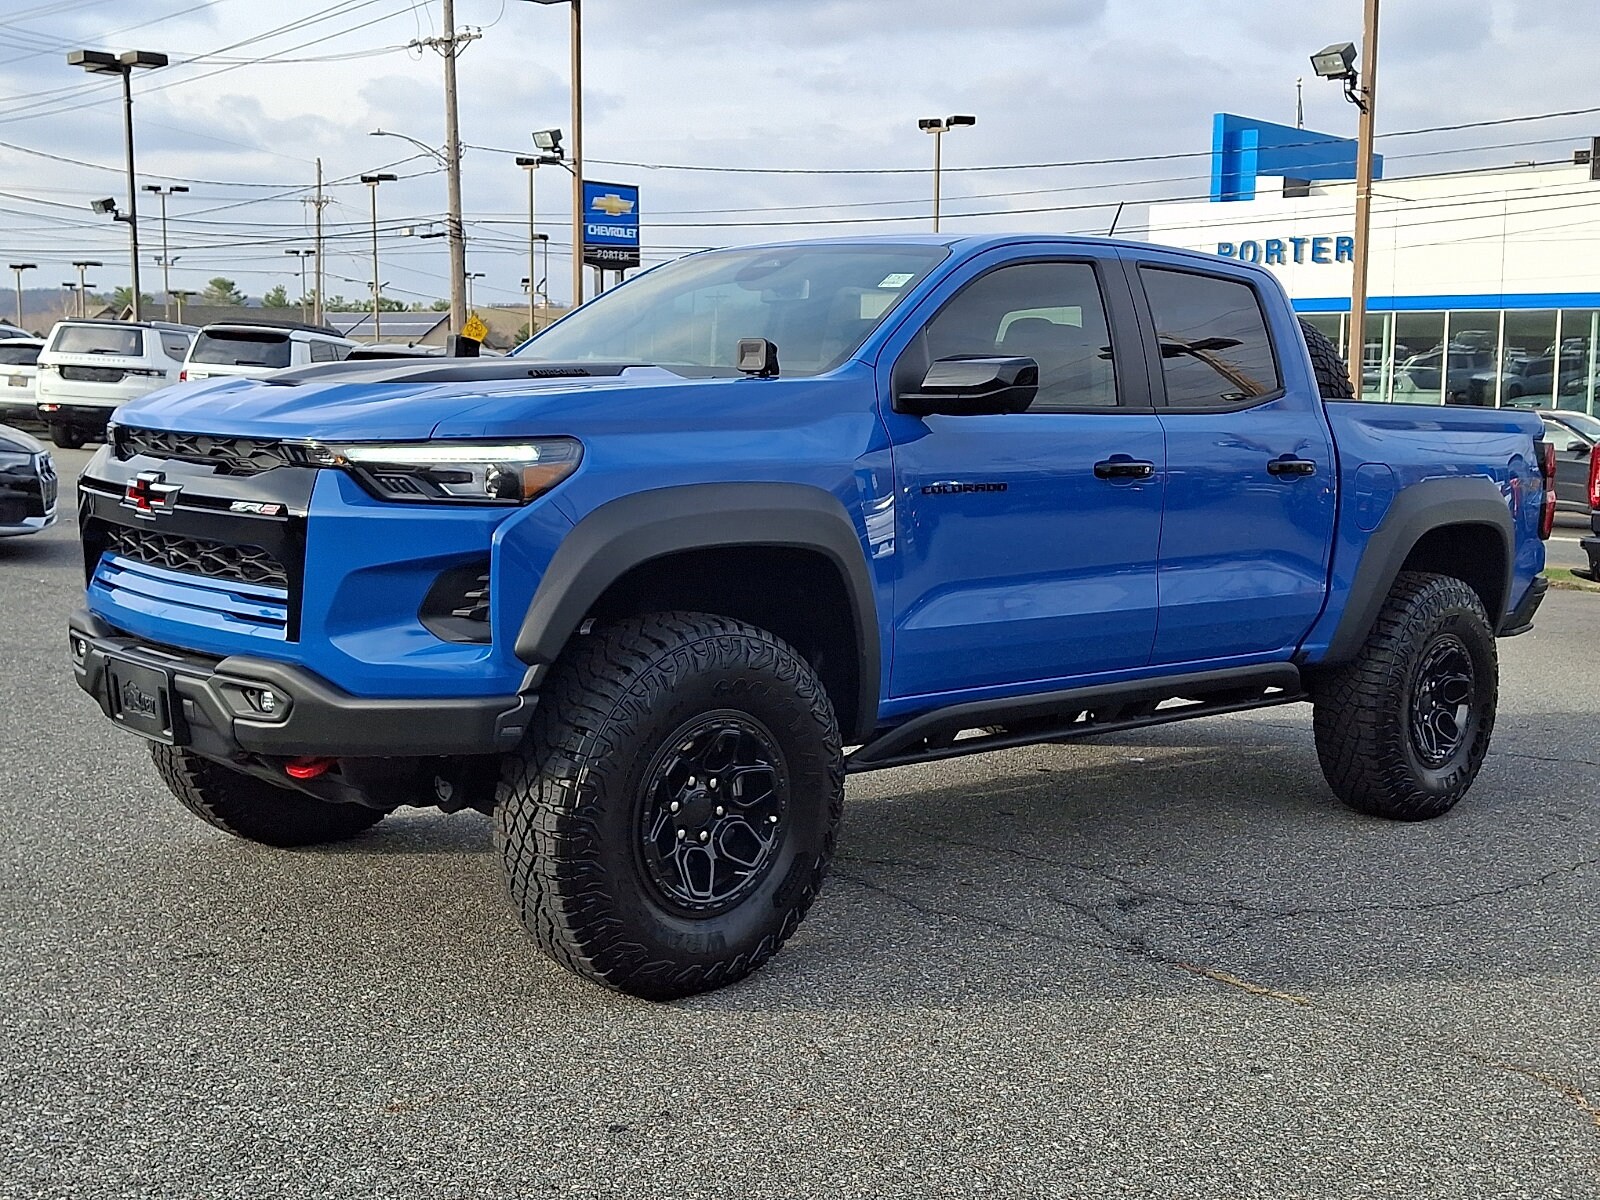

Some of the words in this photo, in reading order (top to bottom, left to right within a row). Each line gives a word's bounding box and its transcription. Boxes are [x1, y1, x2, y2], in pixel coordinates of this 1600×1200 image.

[588, 225, 637, 238] CHEVROLET
[597, 249, 630, 260] PORTER
[1217, 236, 1354, 264] PORTER
[922, 482, 1007, 494] COLORADO
[229, 501, 280, 516] ZR2
